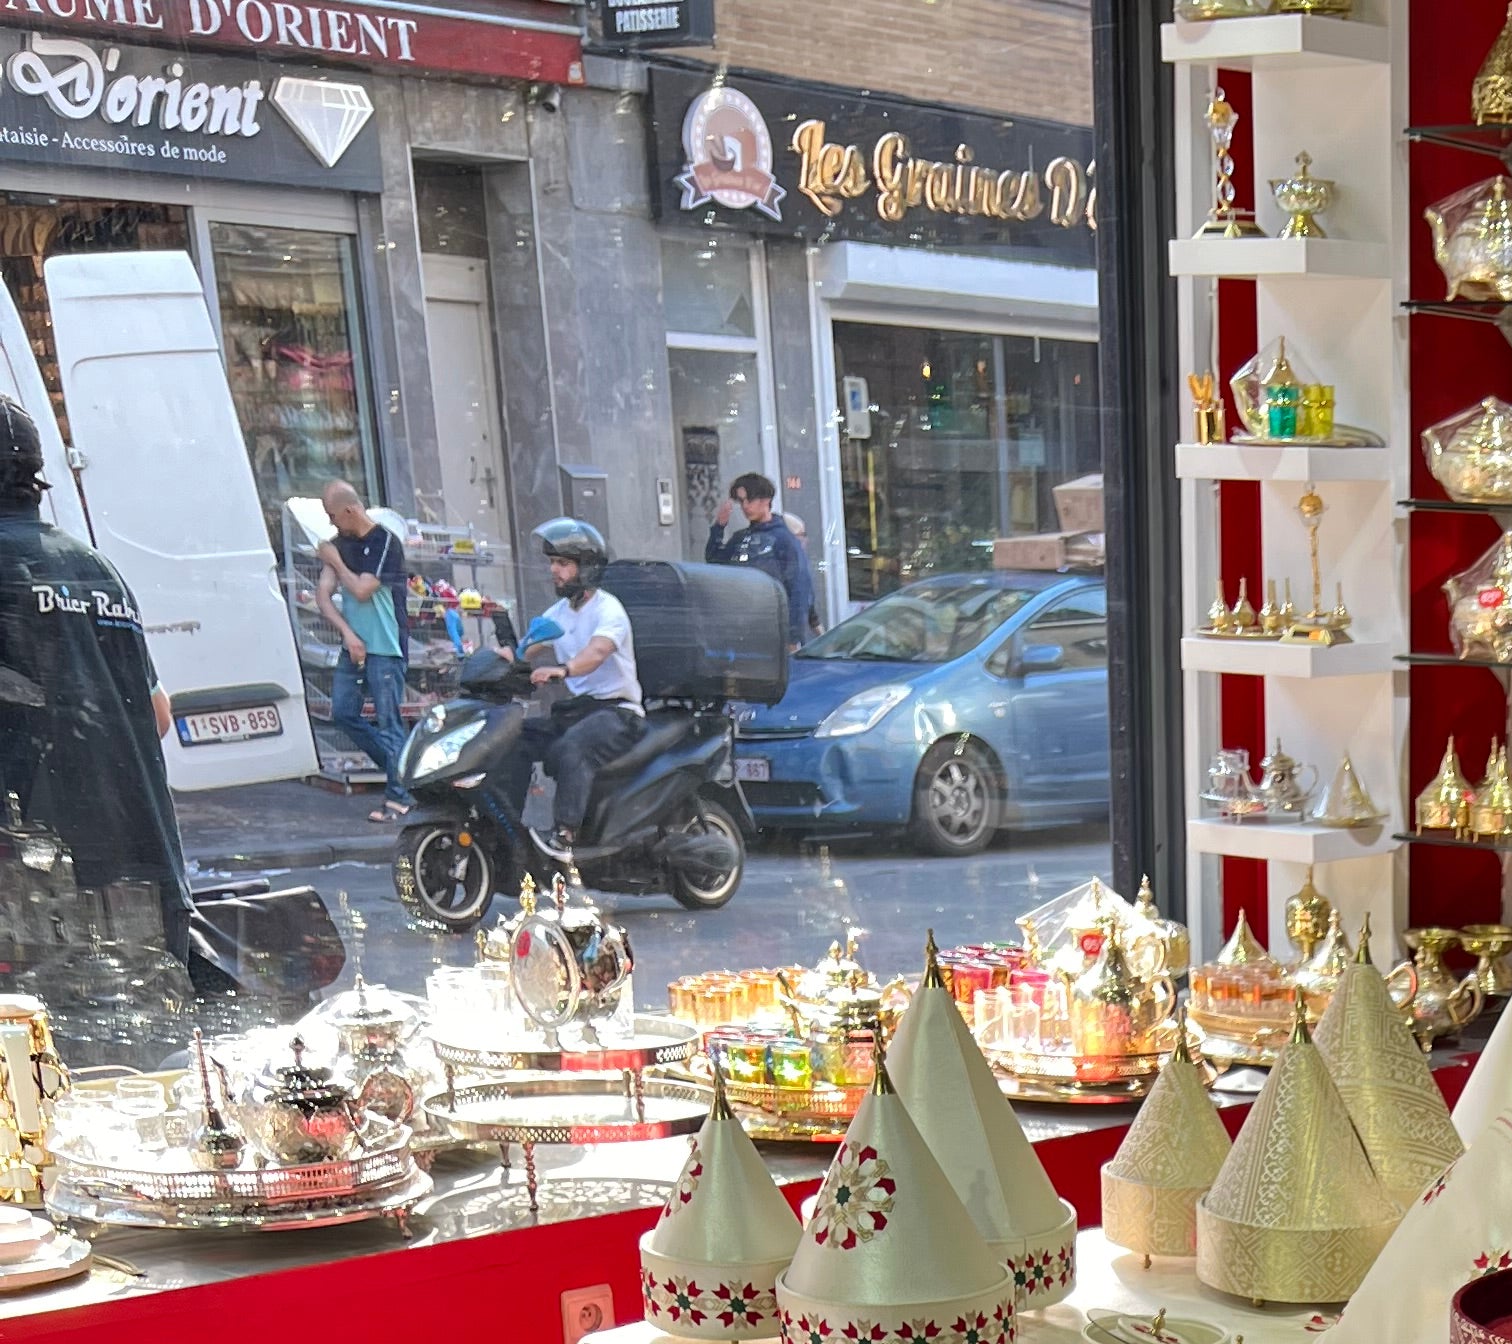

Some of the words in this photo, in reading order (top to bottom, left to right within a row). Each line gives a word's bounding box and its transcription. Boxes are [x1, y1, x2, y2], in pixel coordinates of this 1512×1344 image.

[190, 0, 417, 61] D'ORIENT
[62, 131, 156, 158] Accessoires
[160, 141, 180, 159] de
[184, 144, 228, 163] mode
[792, 118, 870, 218] Les
[873, 131, 1044, 222] Graines
